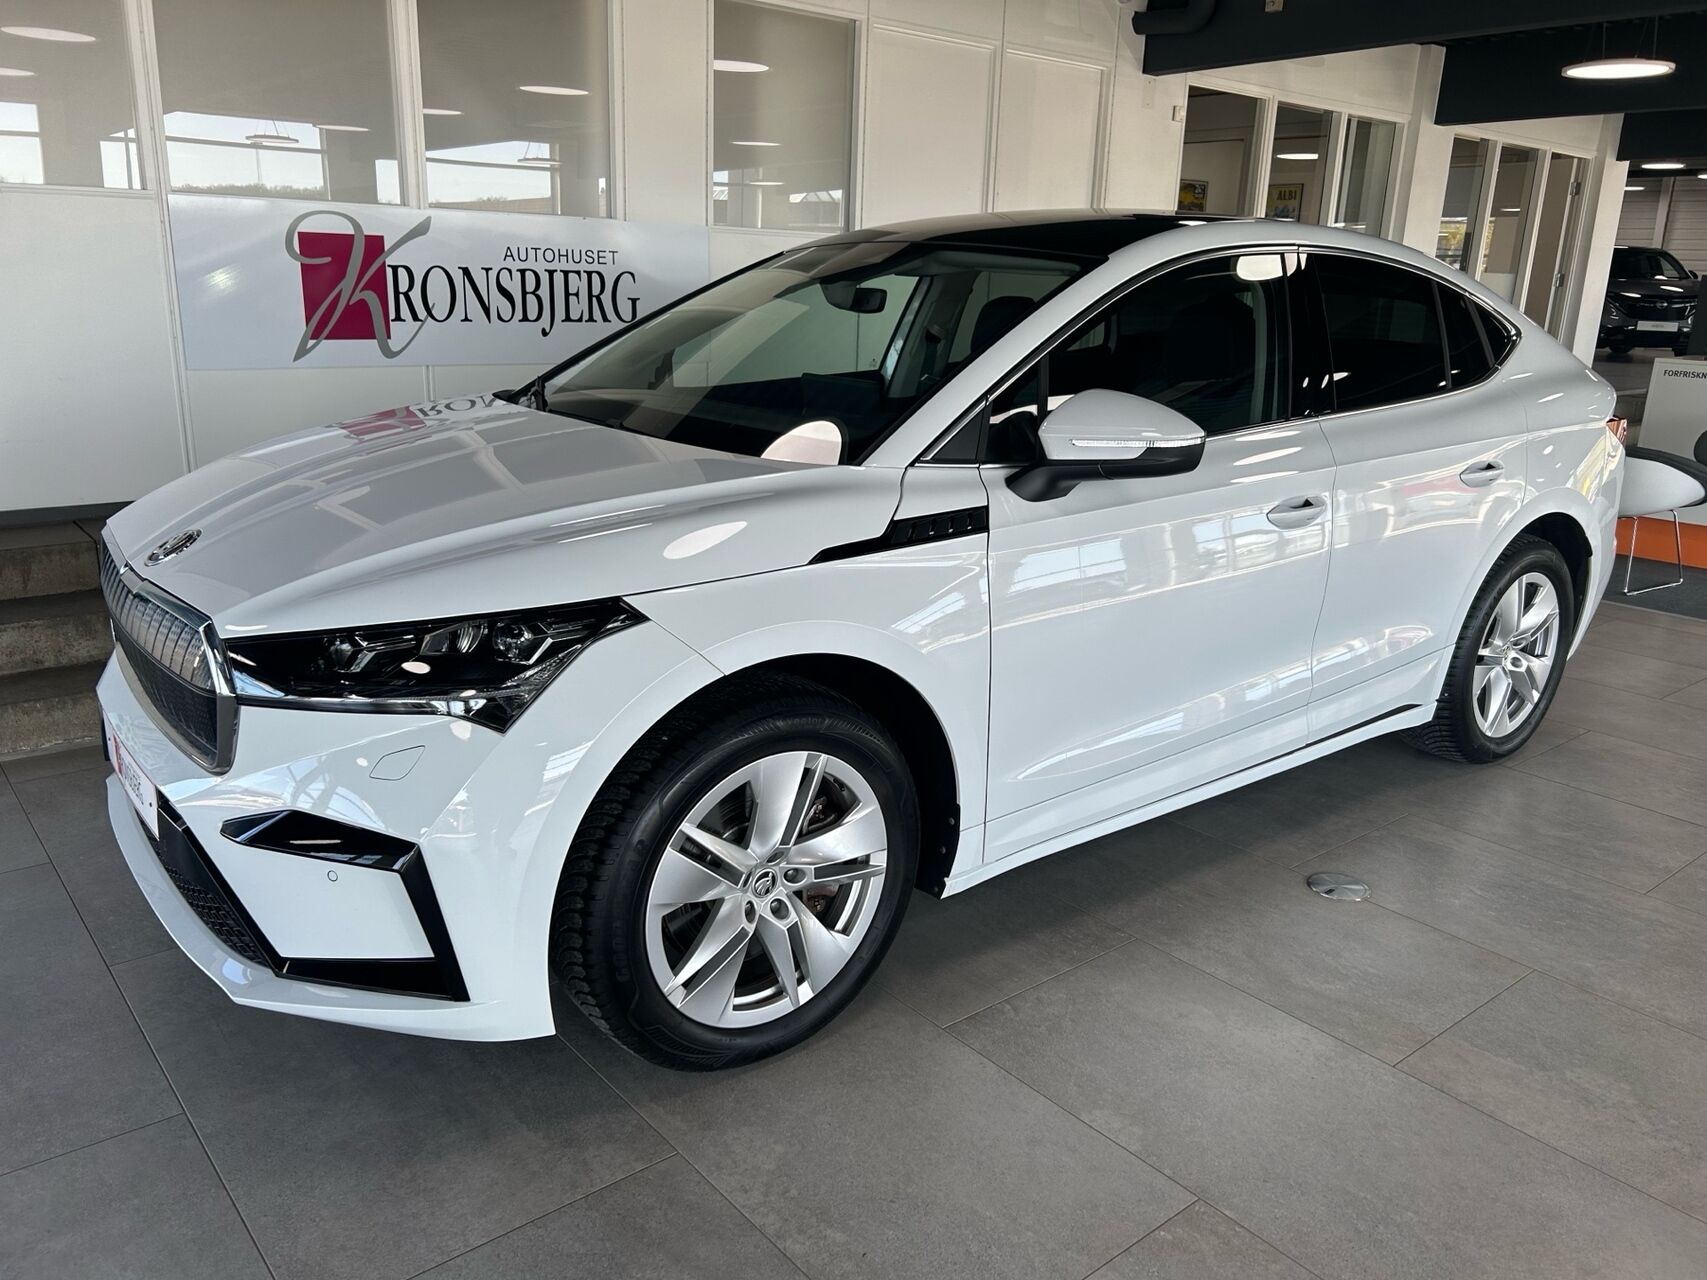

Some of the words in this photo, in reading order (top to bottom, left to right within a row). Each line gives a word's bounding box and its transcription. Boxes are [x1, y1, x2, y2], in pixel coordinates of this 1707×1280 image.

[1276, 189, 1297, 201] ALBI
[503, 246, 619, 266] AUTOHUSET
[284, 210, 641, 362] KRONSBJERG
